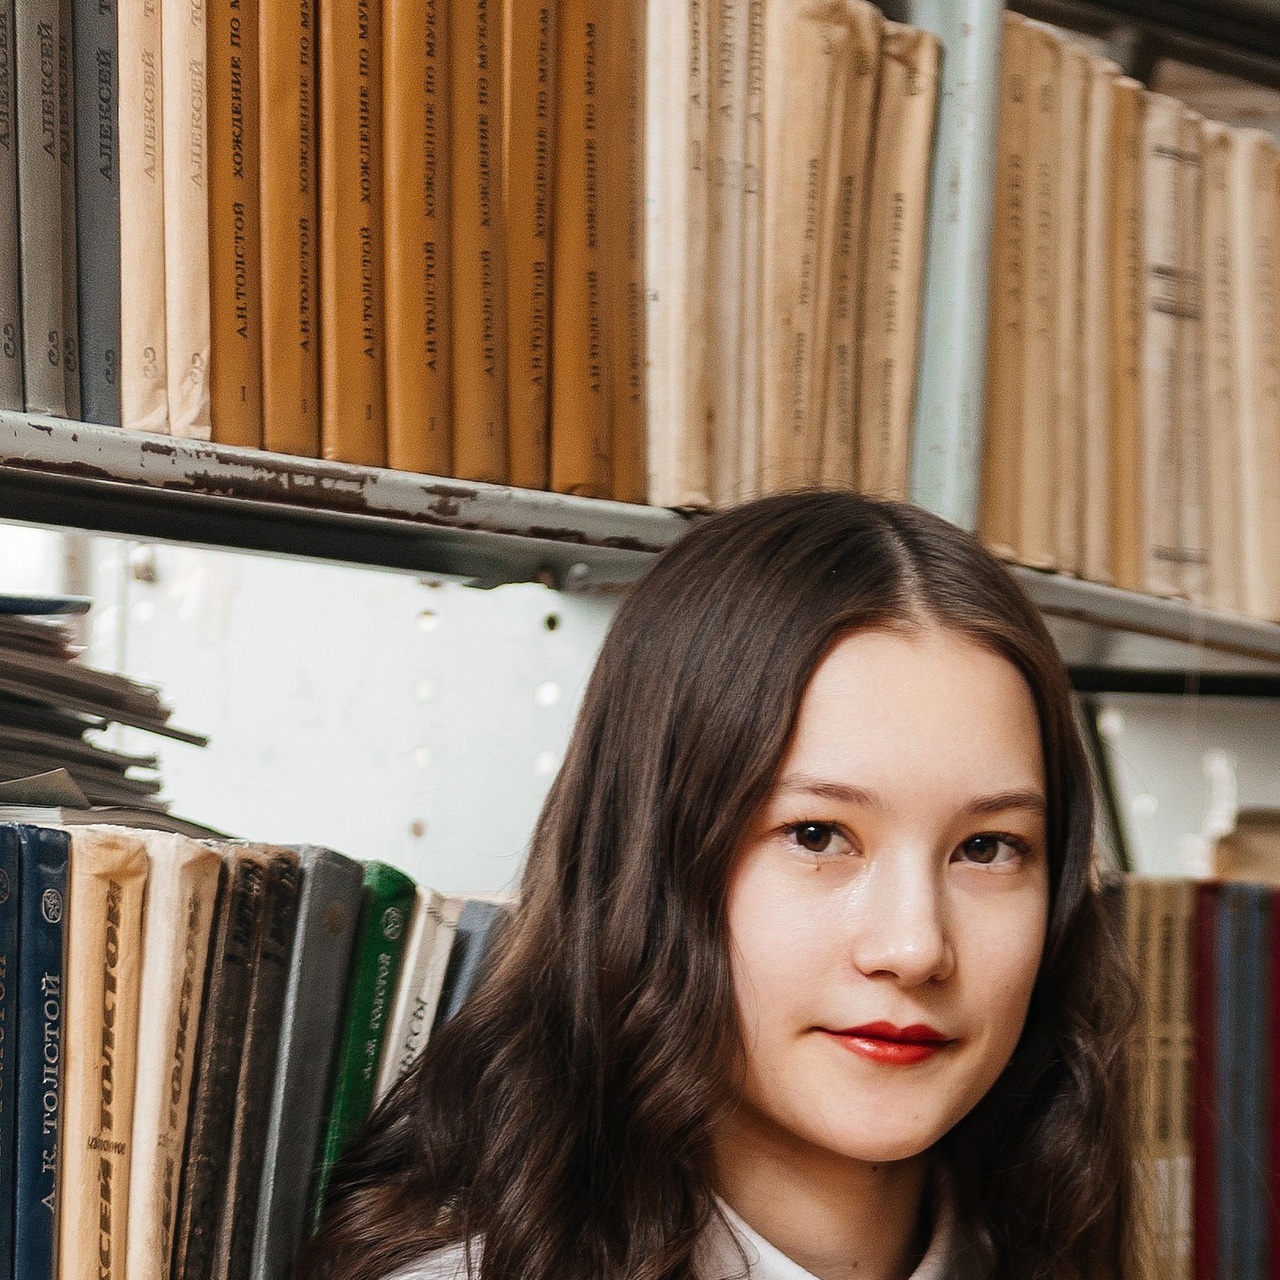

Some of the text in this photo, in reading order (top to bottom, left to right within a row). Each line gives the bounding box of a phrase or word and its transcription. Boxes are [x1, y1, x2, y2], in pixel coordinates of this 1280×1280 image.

[37, 21, 55, 159] АЛЕКСЕЙ
[229, 17, 243, 49] ПО
[299, 36, 310, 66] ПО
[358, 48, 370, 77] ПО
[423, 65, 436, 95] ПО
[97, 47, 113, 182] АЛЕКСЕЙ
[142, 49, 156, 180] АЛЕКСЕЙ
[189, 58, 203, 188] АЛЕКСЕЙ
[229, 56, 245, 180] ХОЖДЕНИЕ
[299, 76, 311, 194] ХОЖДЕНИЕ
[358, 88, 372, 204] ХОЖДЕНИЕ
[100, 878, 123, 1133] ТОЛСТОЙ
[41, 971, 61, 1214] А. К. ТОЛСТОЙ
